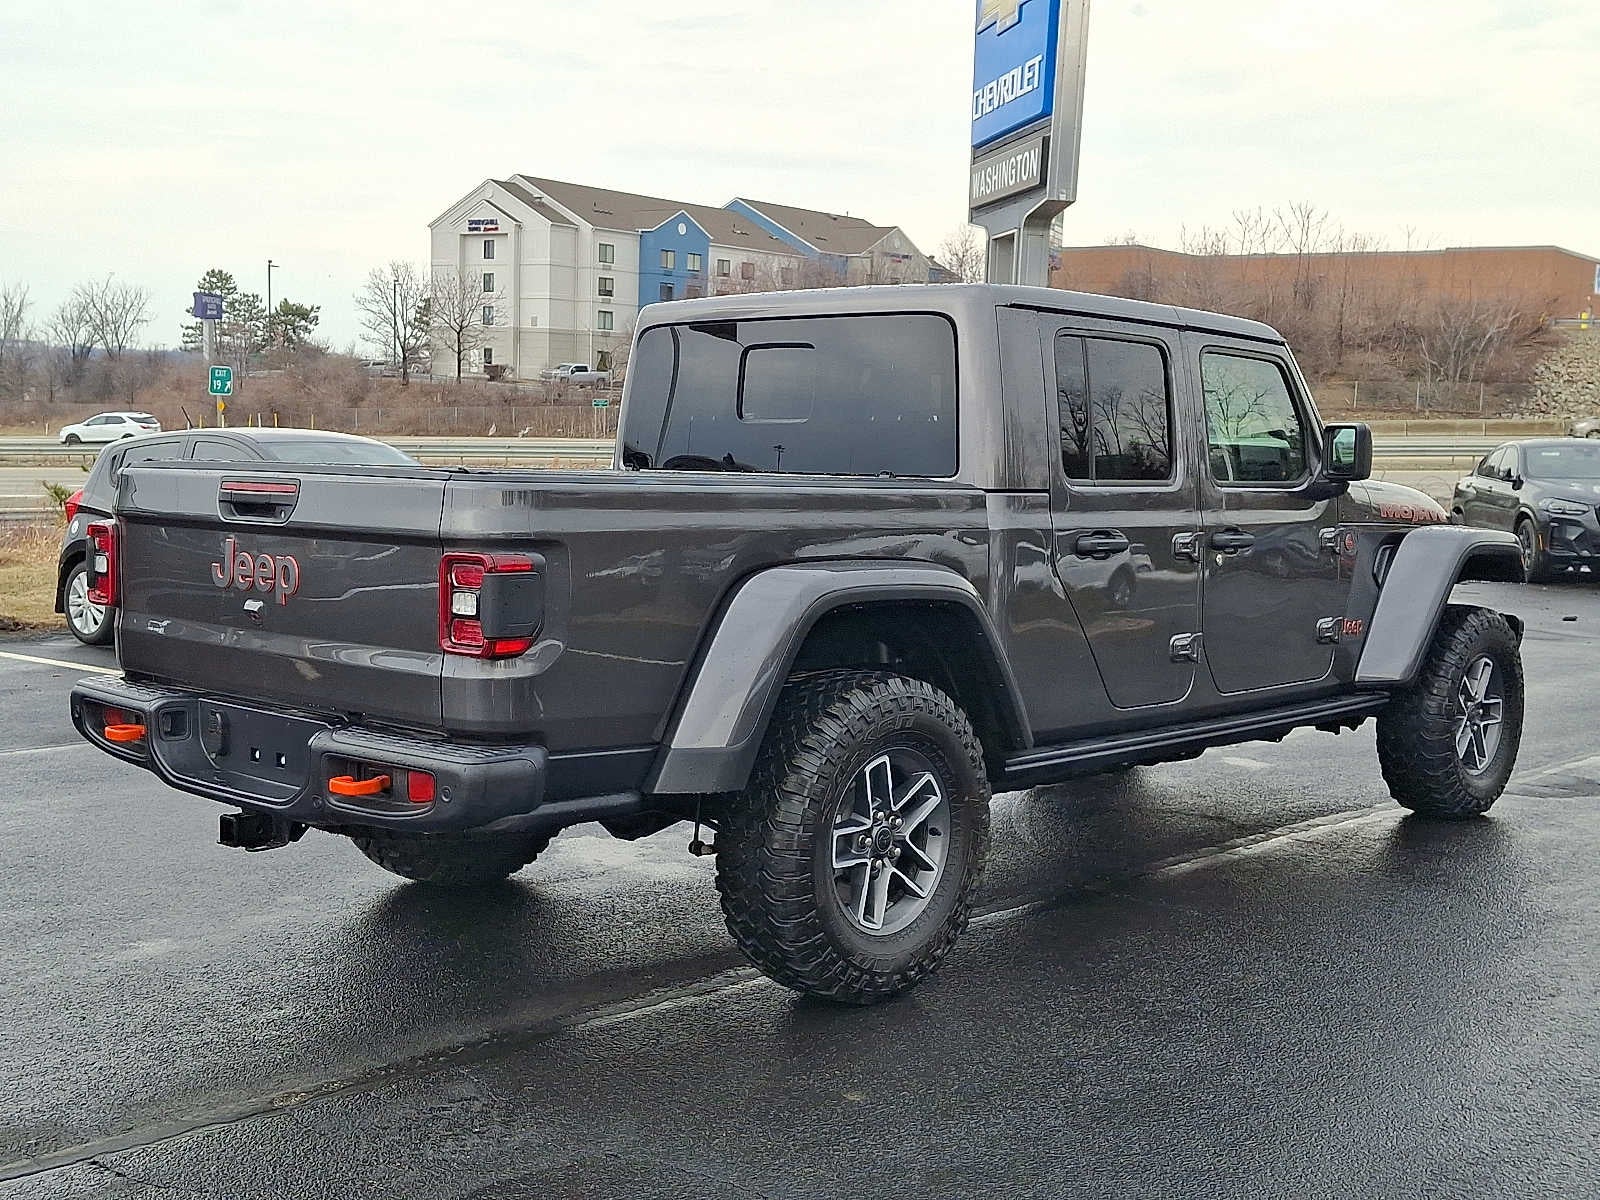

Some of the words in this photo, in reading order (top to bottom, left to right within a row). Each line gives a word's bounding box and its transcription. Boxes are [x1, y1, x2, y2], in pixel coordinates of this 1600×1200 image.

[972, 54, 1043, 121] CHEVROLET
[972, 147, 1039, 199] WASHINGTON
[213, 380, 222, 390] 19
[214, 369, 227, 377] EXIT
[211, 535, 300, 607] Jeep
